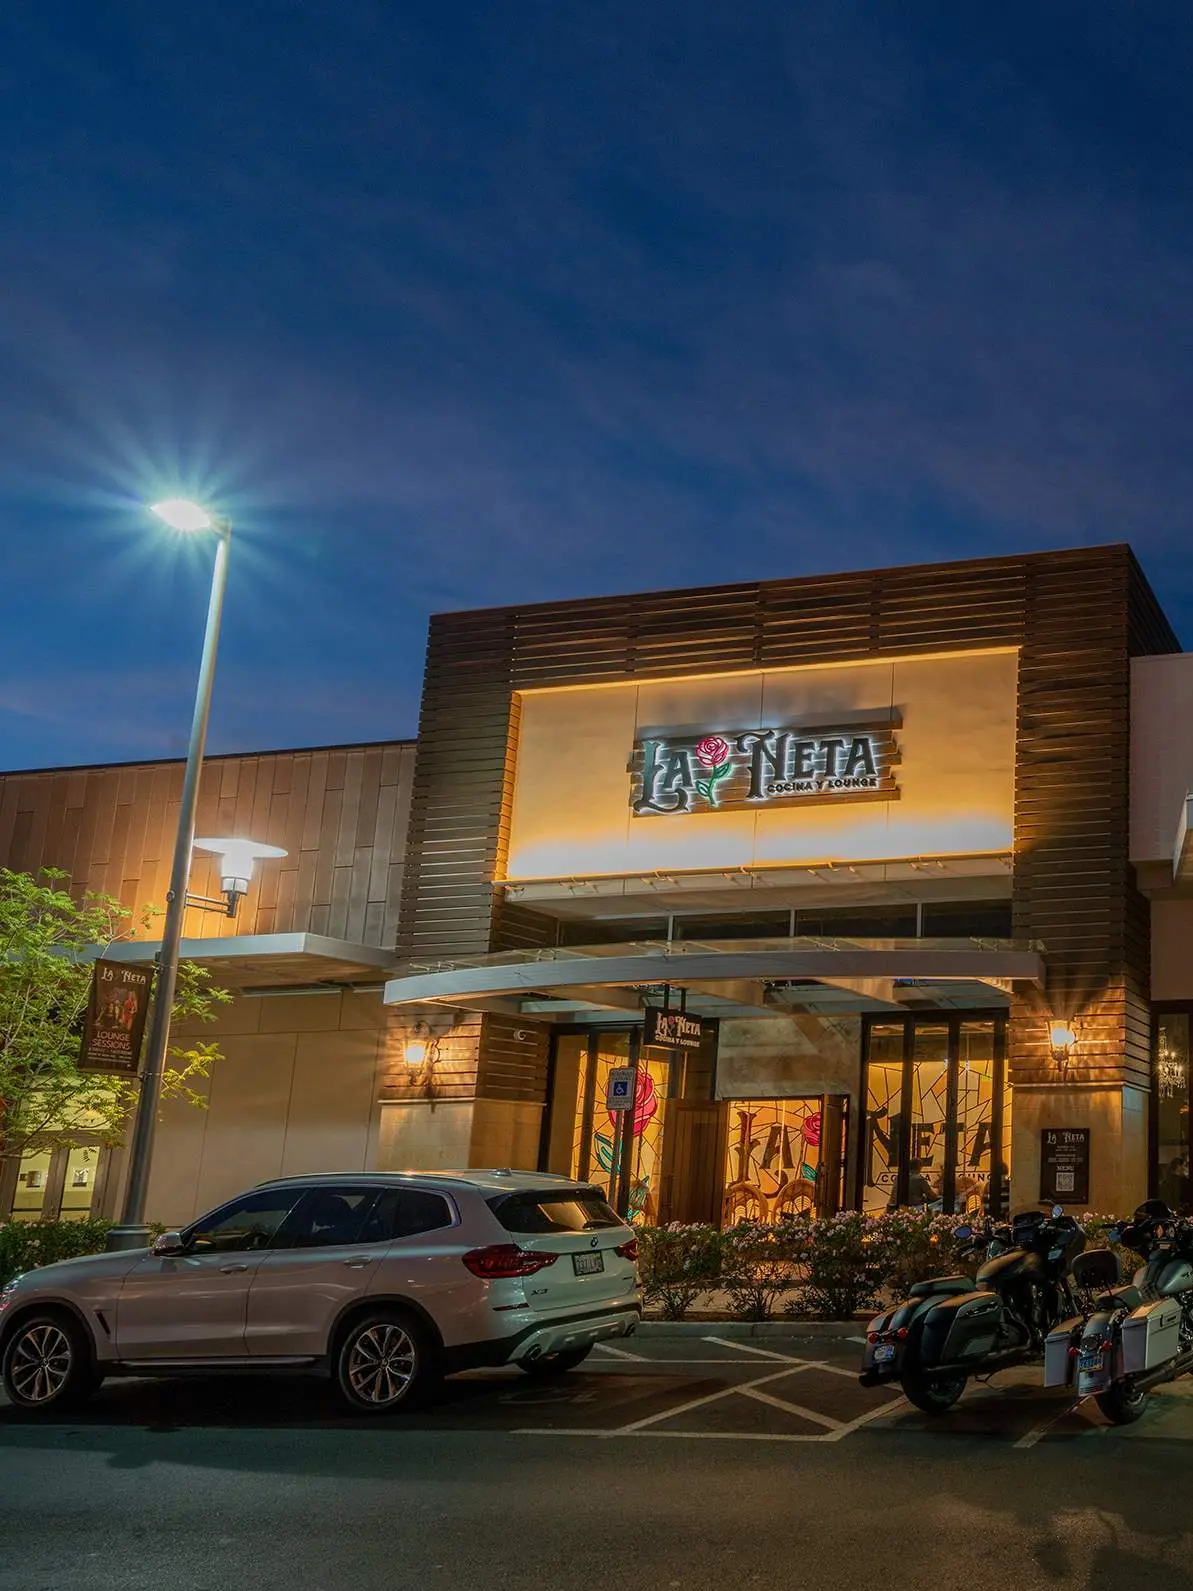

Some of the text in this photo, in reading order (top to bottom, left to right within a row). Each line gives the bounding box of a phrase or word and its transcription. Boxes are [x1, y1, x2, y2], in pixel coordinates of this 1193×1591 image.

[633, 729, 878, 813] LA NETA
[767, 777, 877, 793] COCINA Y LOUNGE
[101, 967, 146, 985] LA NETA
[655, 1011, 701, 1037] LA NETA
[92, 1039, 131, 1051] SESSIONS
[97, 1031, 131, 1042] LOUNGE
